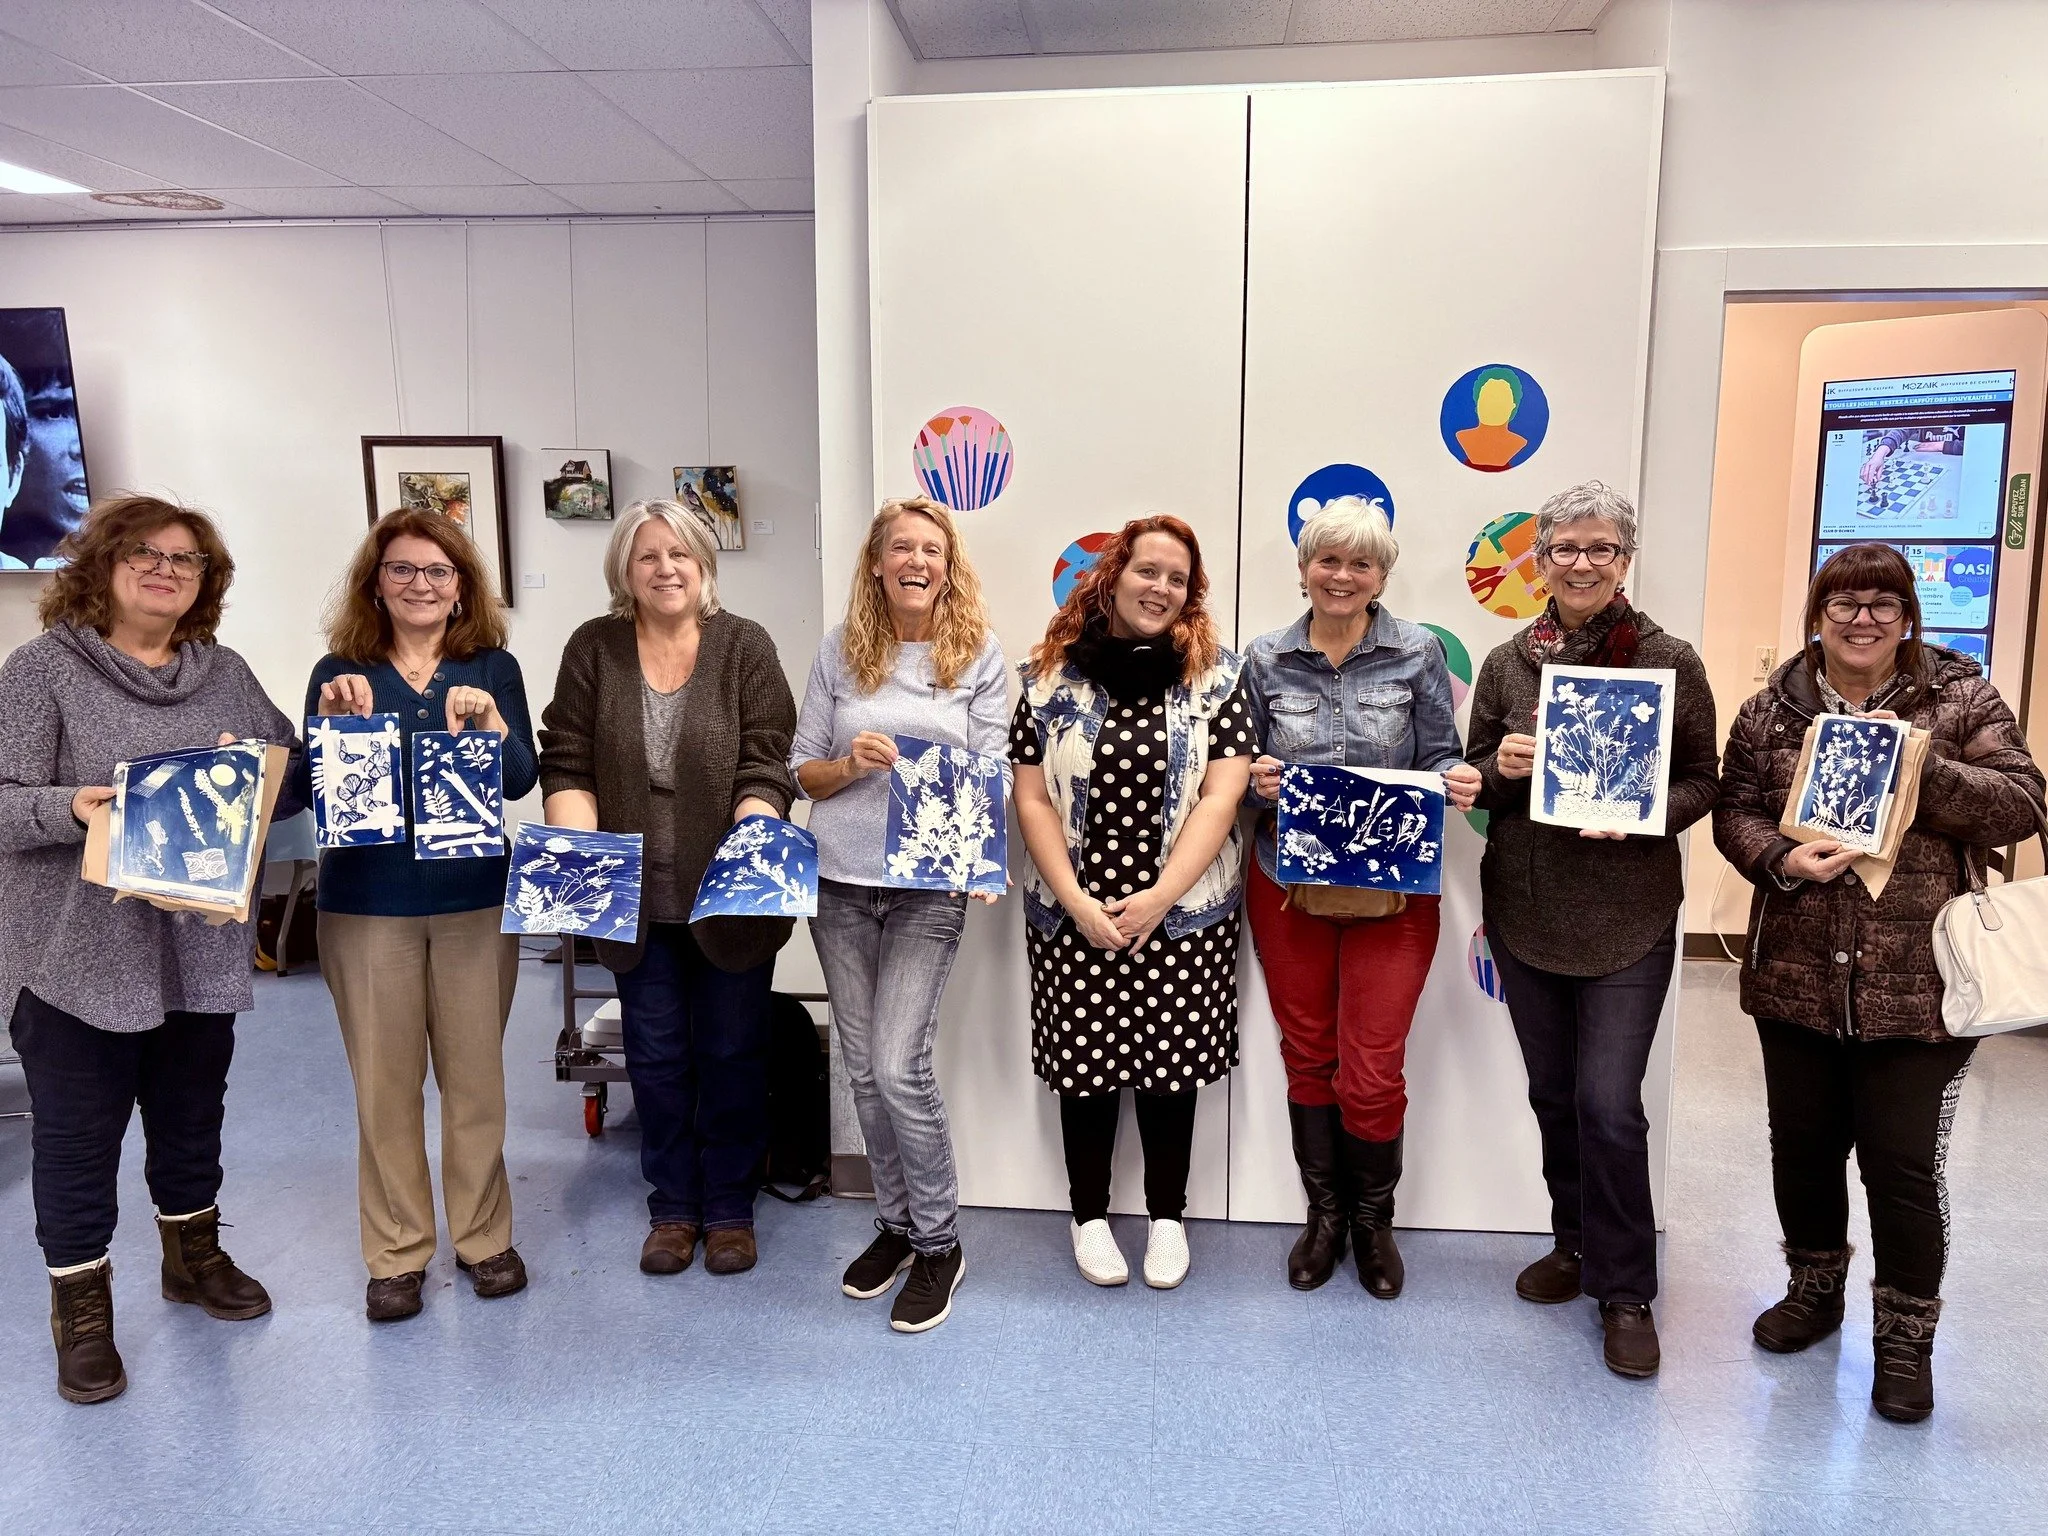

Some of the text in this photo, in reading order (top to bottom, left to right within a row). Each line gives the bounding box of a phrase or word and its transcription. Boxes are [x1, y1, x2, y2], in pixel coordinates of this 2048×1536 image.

[2011, 489, 2019, 518] APPUYEZ
[2017, 478, 2027, 518] SUR L'ÉCRAN
